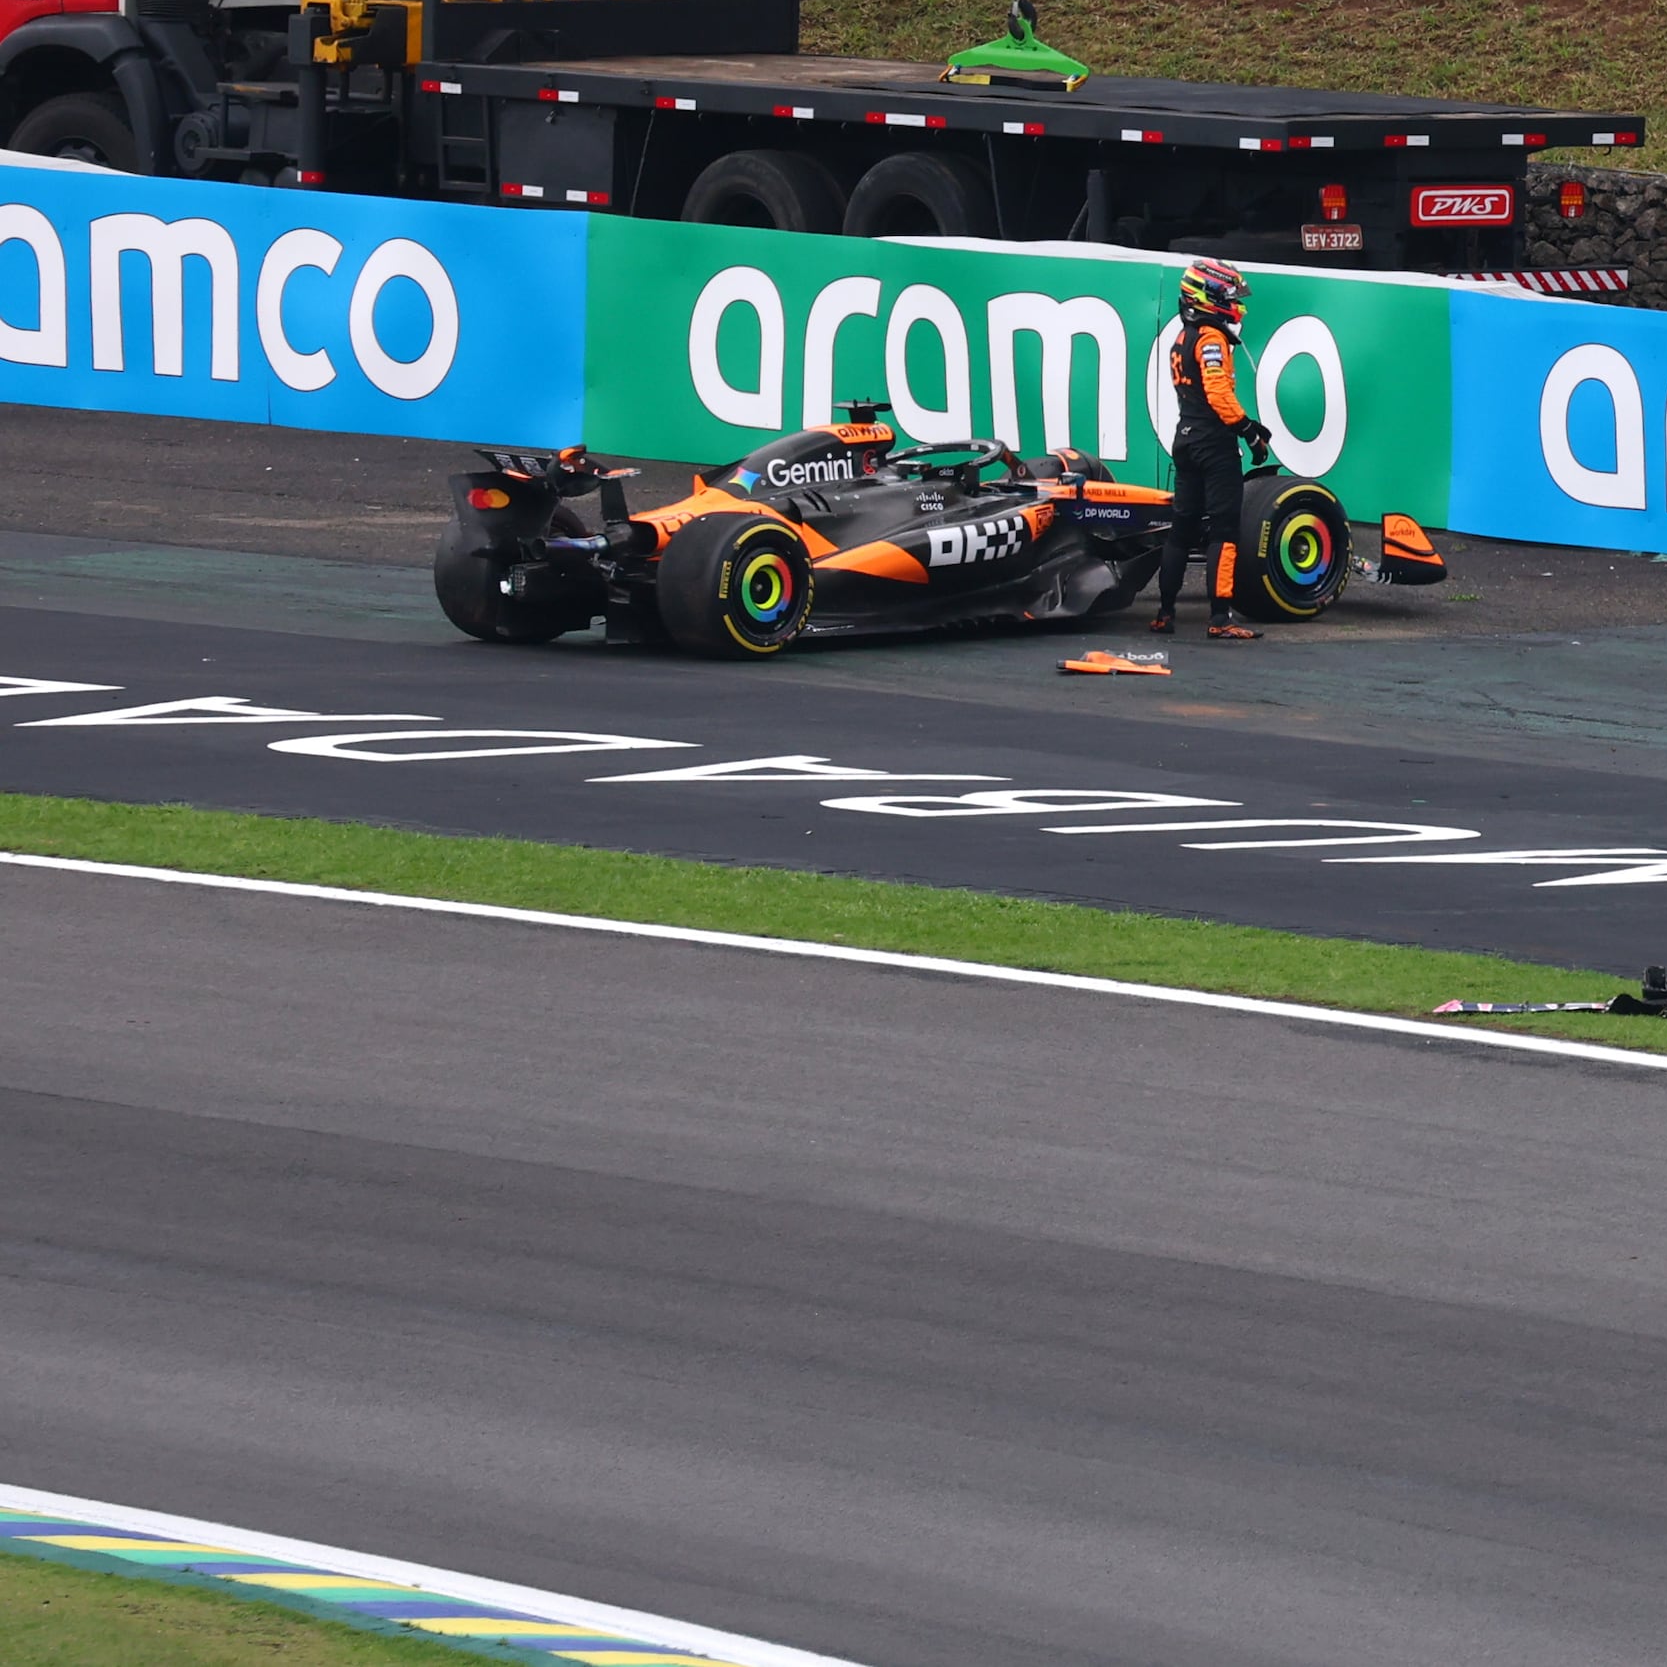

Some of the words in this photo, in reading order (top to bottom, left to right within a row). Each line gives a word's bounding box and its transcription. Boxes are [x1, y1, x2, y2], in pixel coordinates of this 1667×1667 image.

[1430, 196, 1500, 215] PWS
[767, 451, 854, 487] Gemini
[1085, 508, 1097, 518] DP
[1098, 508, 1130, 519] WORLD
